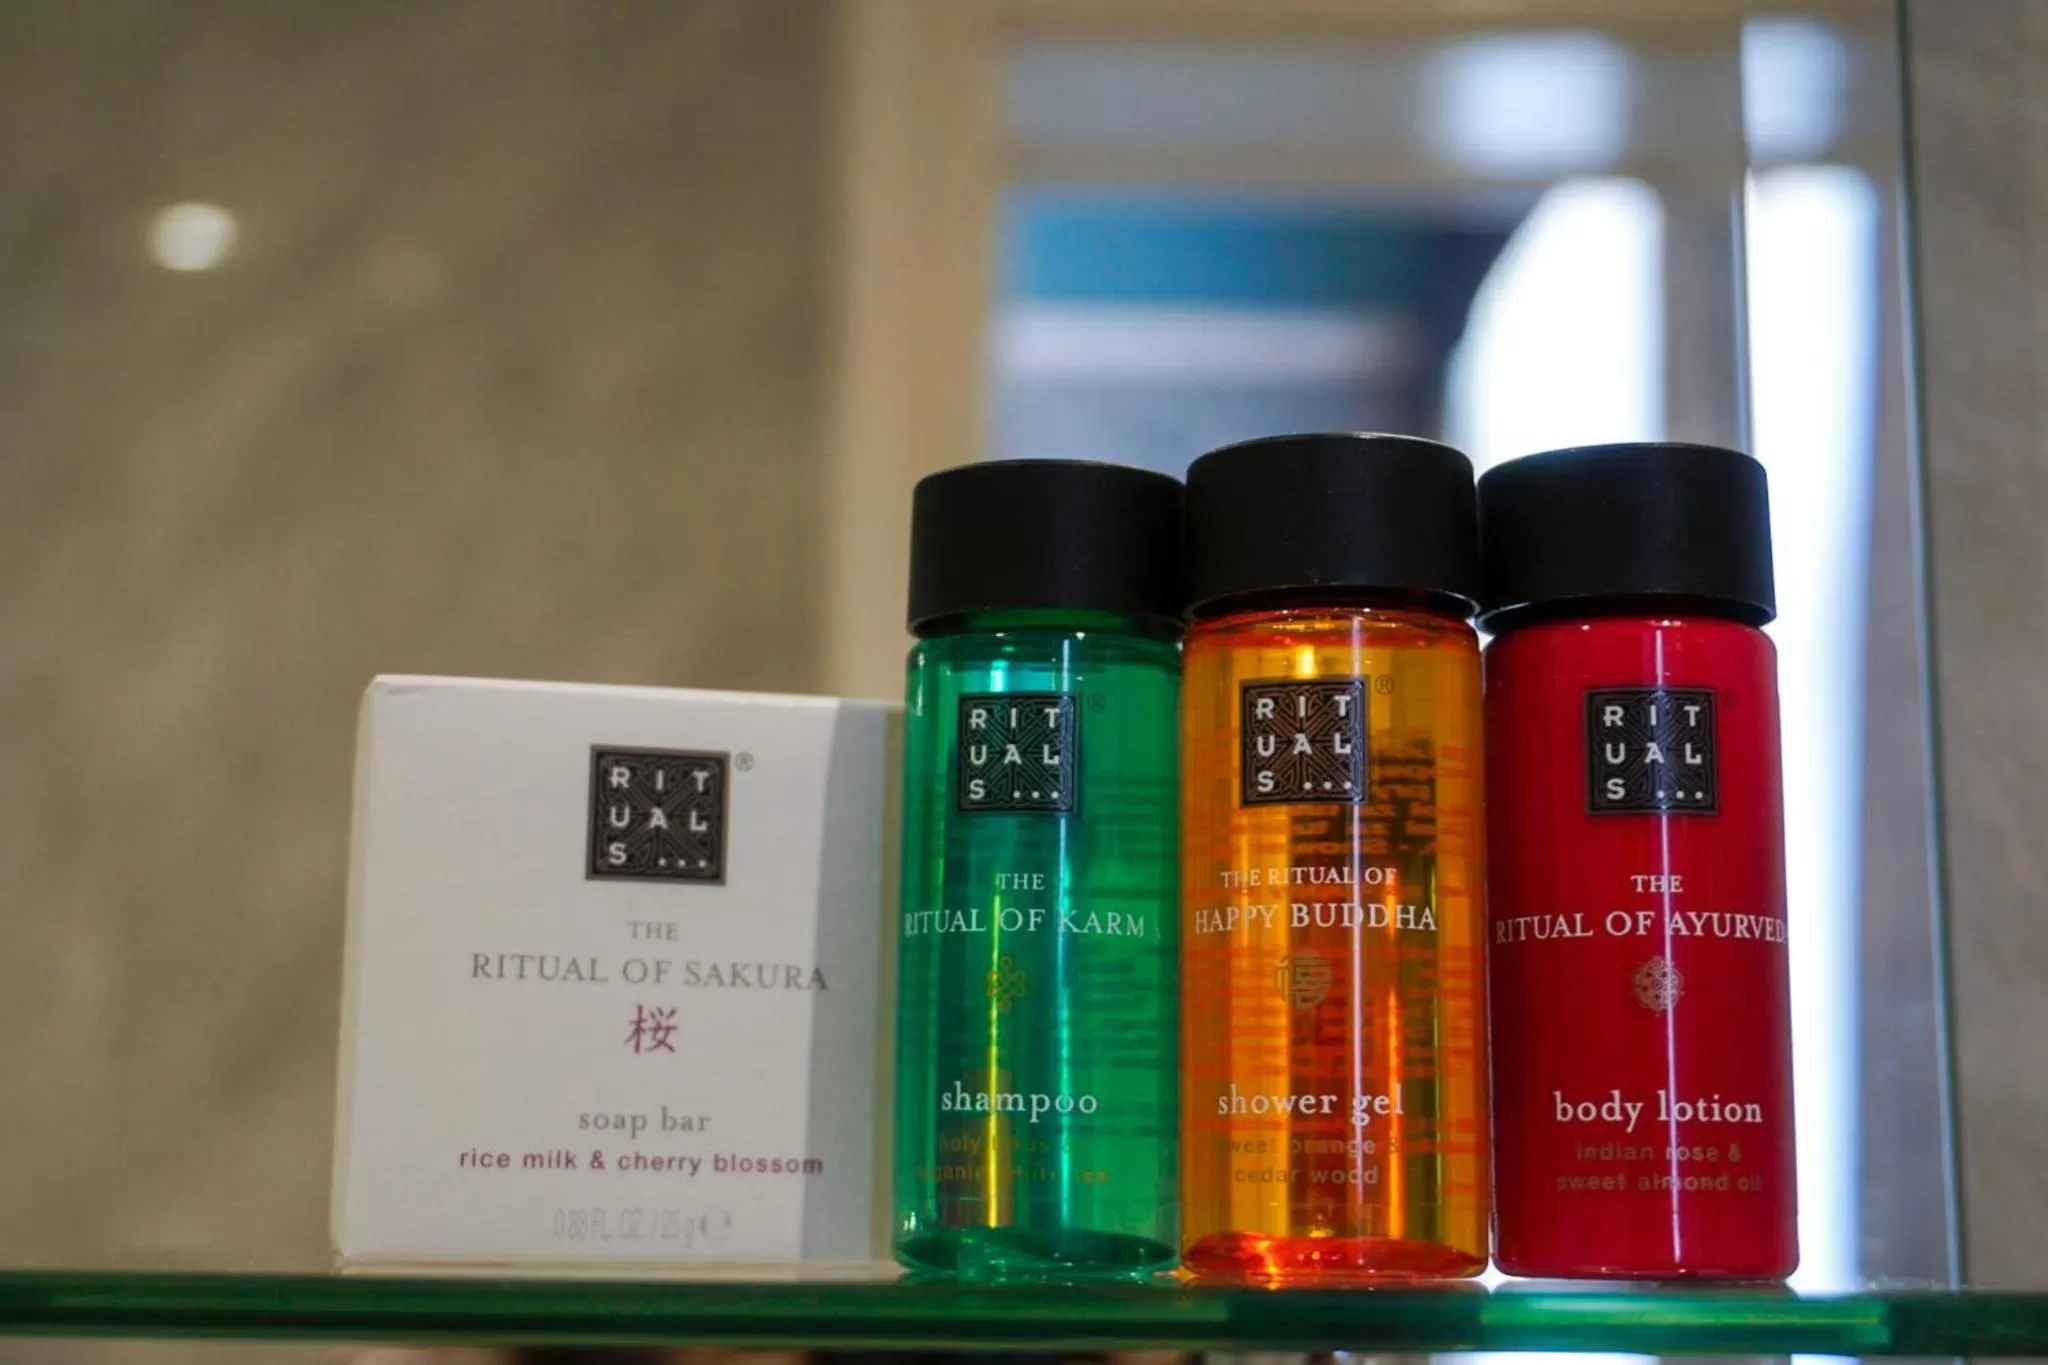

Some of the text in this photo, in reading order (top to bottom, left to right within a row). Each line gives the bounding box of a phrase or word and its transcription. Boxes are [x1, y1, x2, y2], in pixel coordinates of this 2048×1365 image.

[996, 873, 1046, 891] THE
[1220, 867, 1398, 889] THE RITUAL OF
[1630, 875, 1683, 892] THE
[627, 920, 679, 942] THE
[904, 908, 987, 938] RITUAL
[999, 907, 1046, 932] OF
[1195, 902, 1438, 935] HAPPY BUDDHA
[1495, 913, 1594, 944] RITUAL
[1605, 912, 1656, 937] OF
[471, 952, 829, 991] RITUAL OF SAKURA
[625, 1003, 679, 1054] 桜
[941, 1081, 1098, 1123] shampoo
[1217, 1083, 1404, 1126] shower gel
[1553, 1089, 1763, 1133] body lotion
[578, 1105, 712, 1140] soap bar
[459, 1148, 824, 1177] rice milk & cherry blossom
[1291, 1139, 1376, 1158] orange
[1577, 1142, 1654, 1161] indian
[1665, 1145, 1718, 1161] rose
[1235, 1166, 1379, 1185] cedar wood
[1556, 1173, 1627, 1191] sweet
[1637, 1172, 1729, 1191] almond
